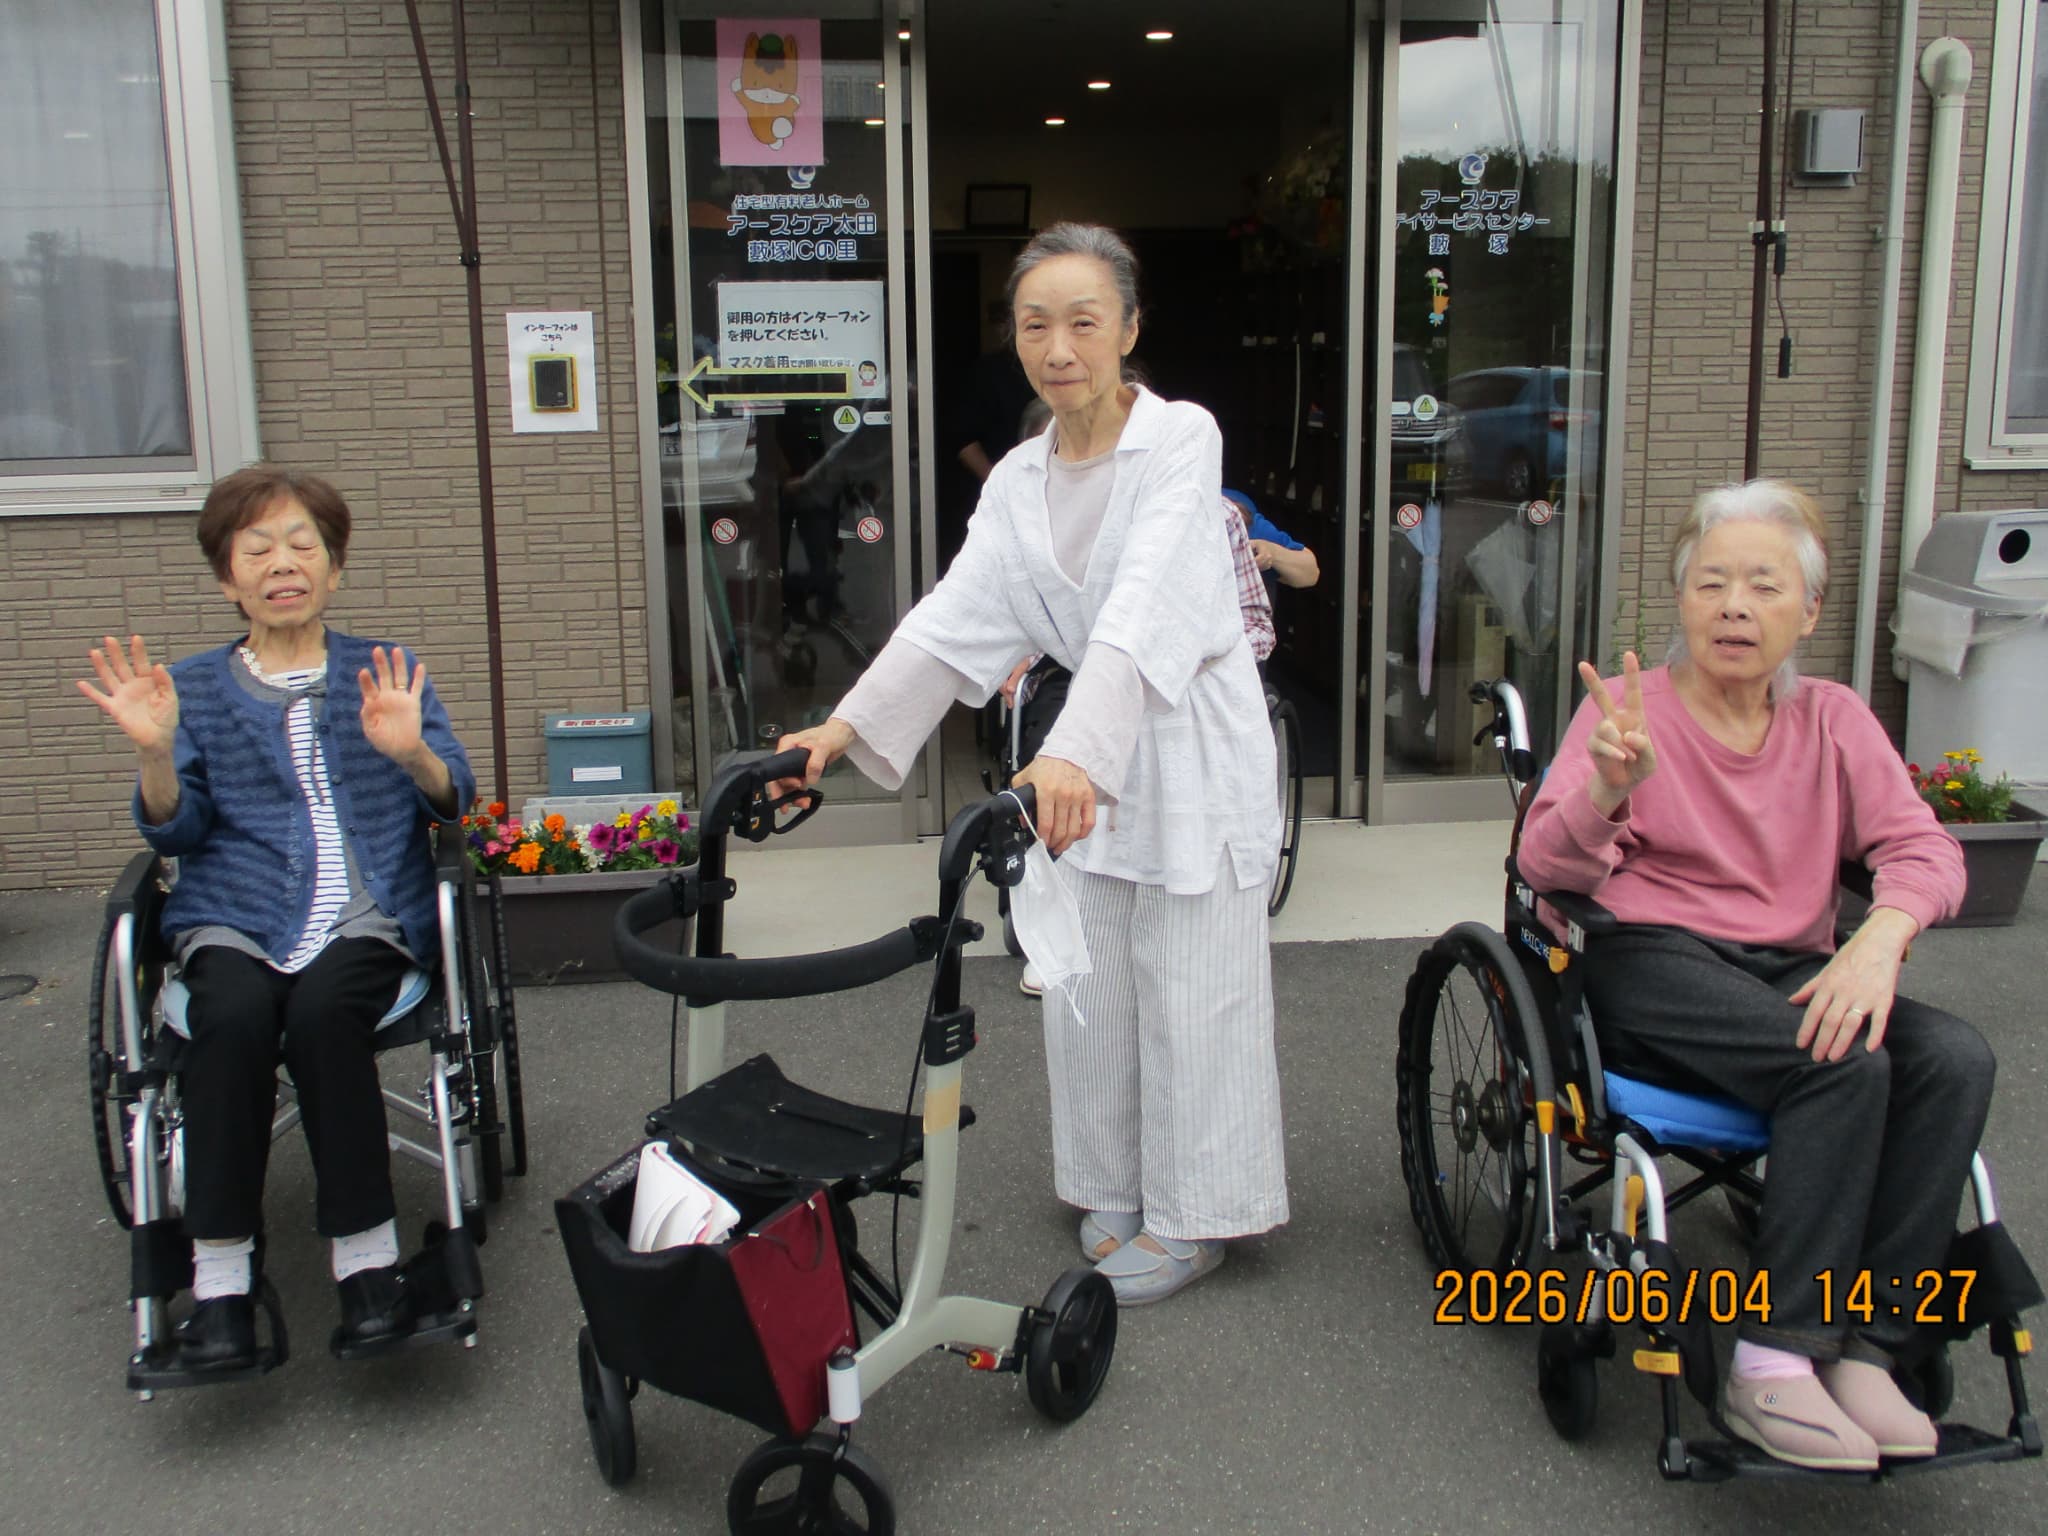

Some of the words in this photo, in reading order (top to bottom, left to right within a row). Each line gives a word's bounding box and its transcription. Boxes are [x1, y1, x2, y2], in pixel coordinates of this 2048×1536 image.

[735, 194, 869, 210] 住宅型有料老人ホーム
[1420, 189, 1520, 210] アースケア
[727, 212, 877, 236] アースケア太田
[727, 310, 871, 325] 御用の方はインターフォン
[524, 323, 578, 332] インターフォンは
[728, 328, 829, 342] を押してください。
[541, 334, 562, 342] こちら
